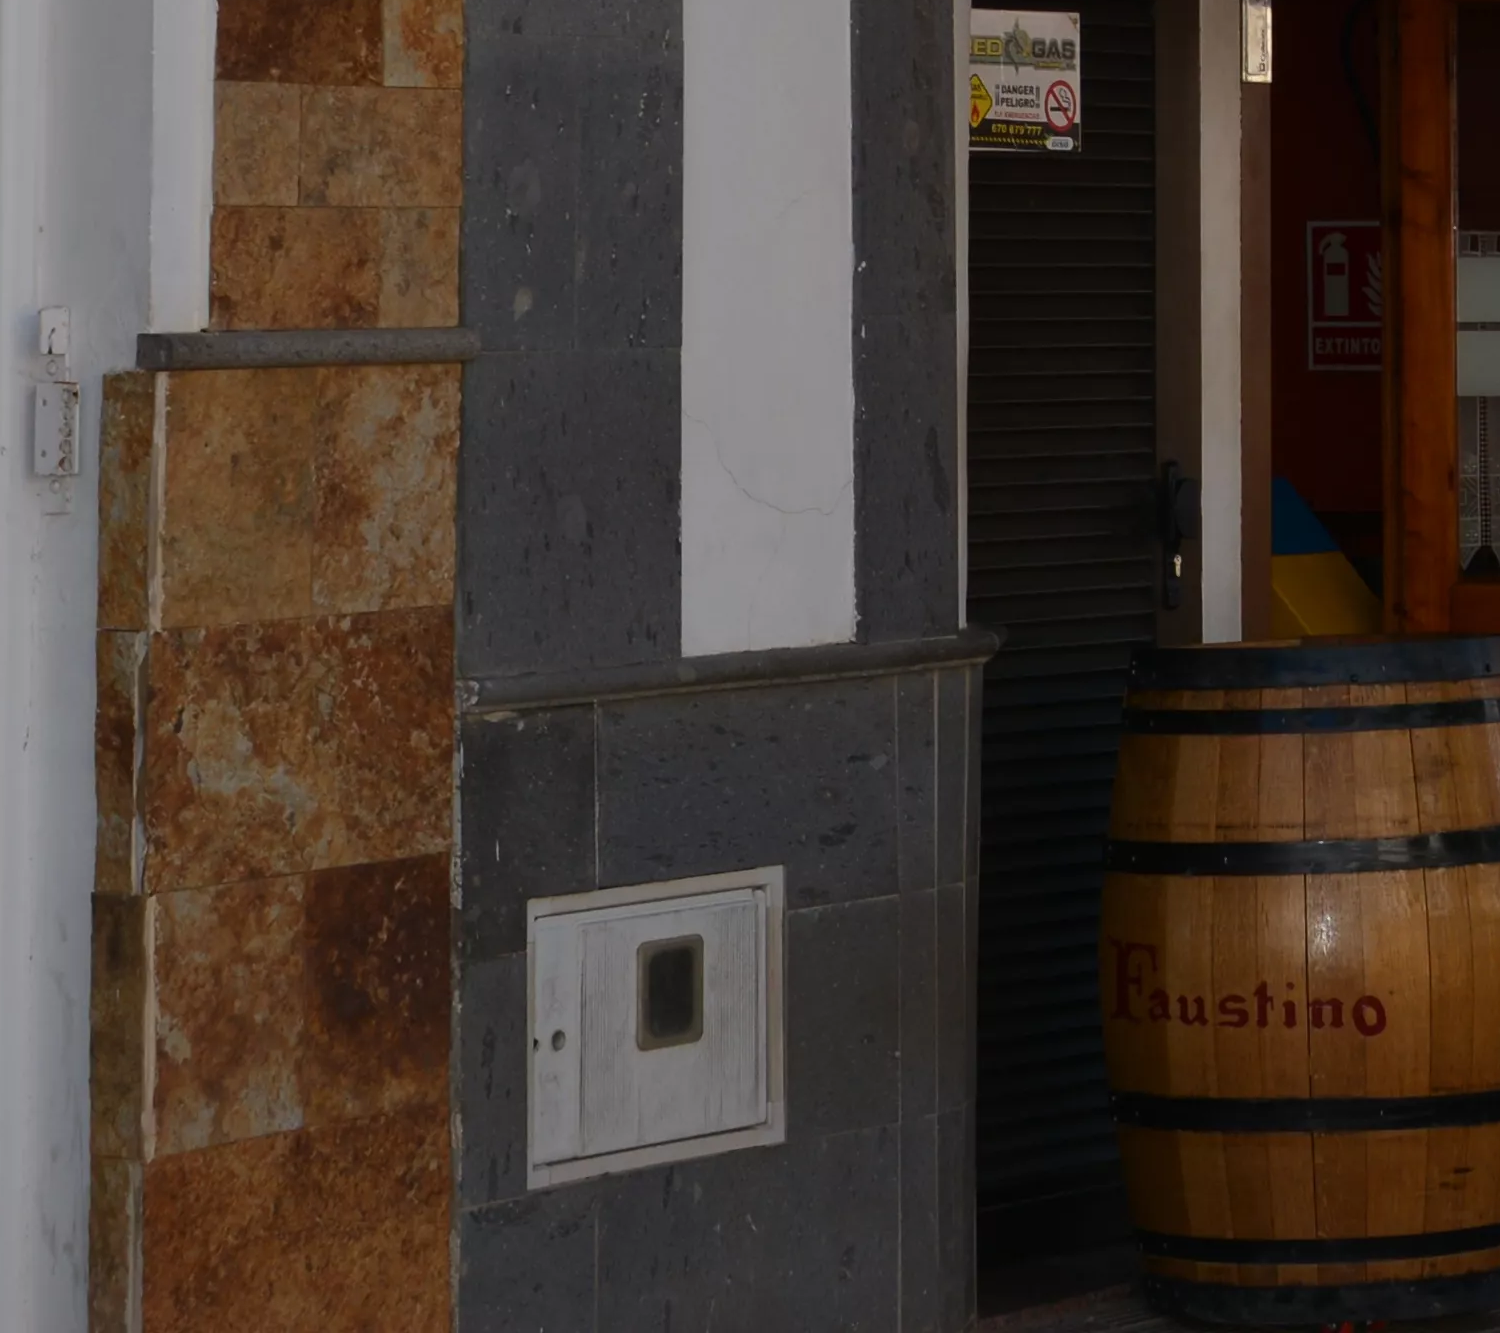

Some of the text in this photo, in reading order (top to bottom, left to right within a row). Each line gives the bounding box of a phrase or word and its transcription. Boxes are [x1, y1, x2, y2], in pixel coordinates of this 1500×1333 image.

[970, 36, 1076, 60] ED GAS
[1107, 934, 1387, 1037] Faustino
